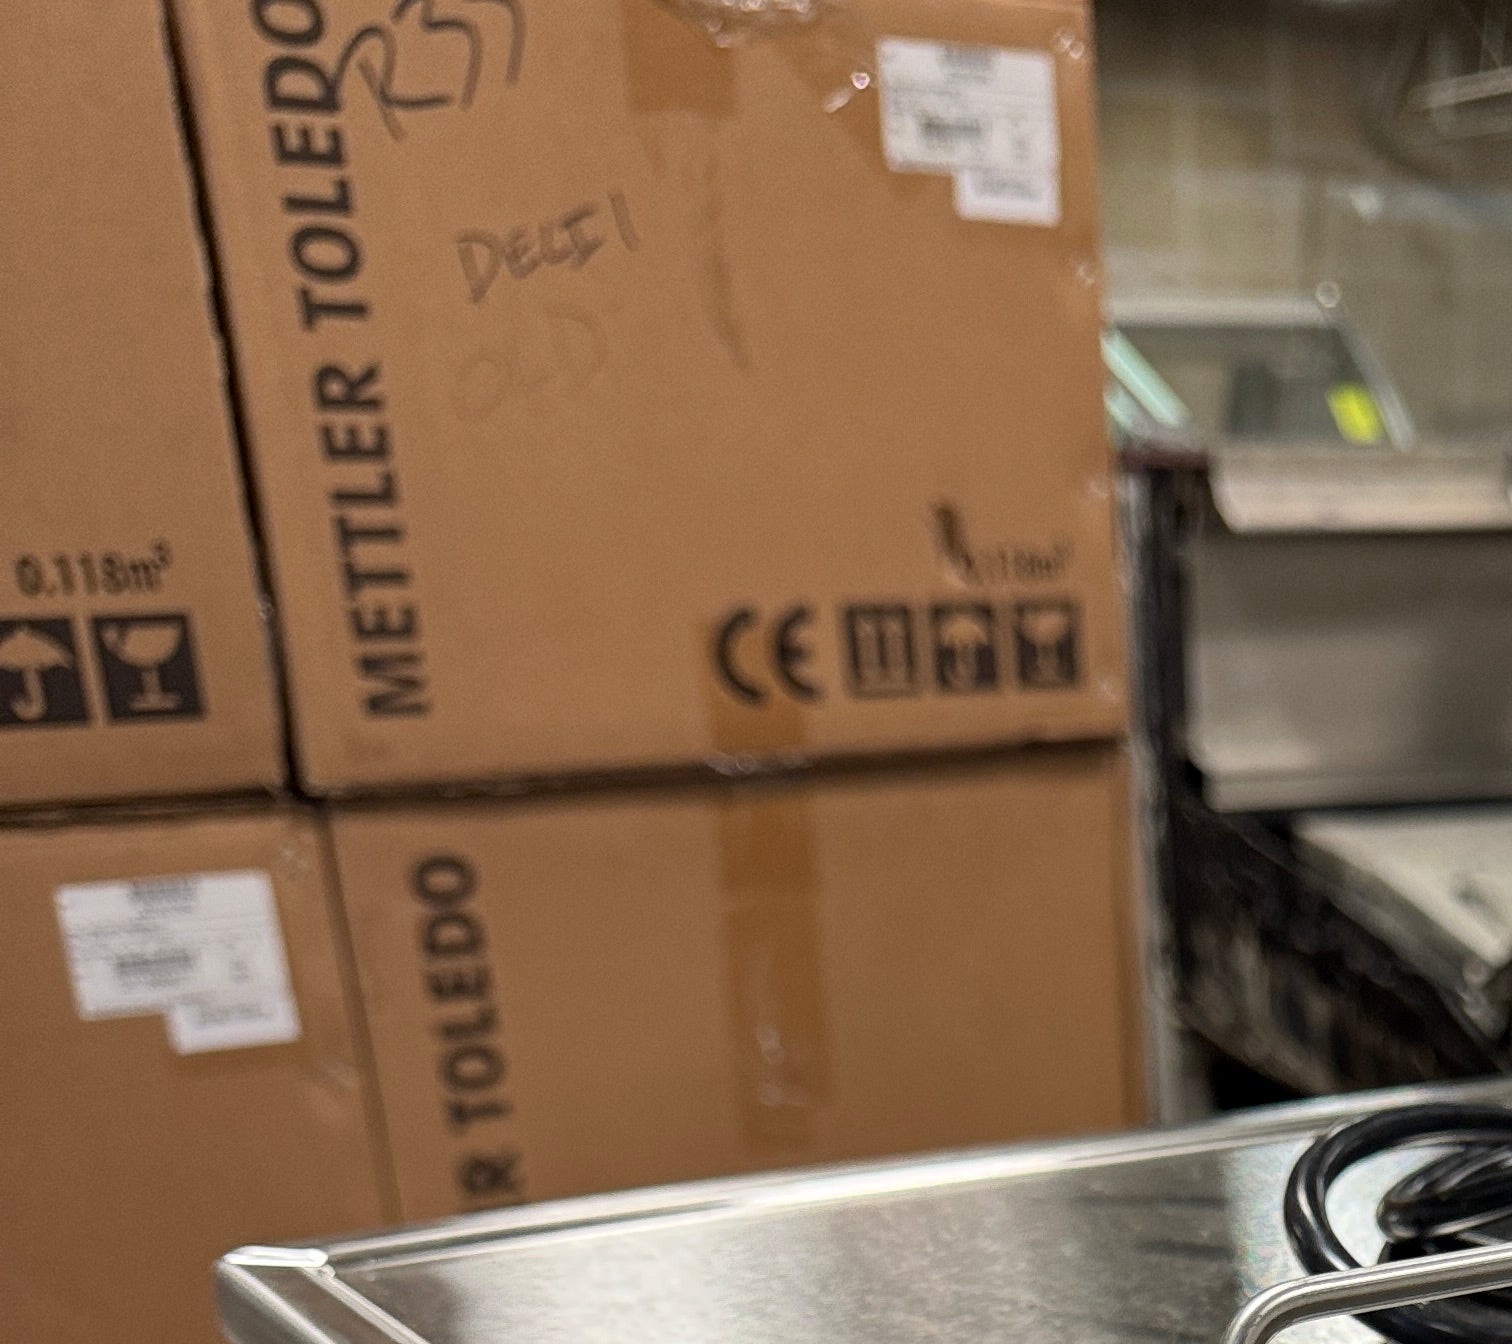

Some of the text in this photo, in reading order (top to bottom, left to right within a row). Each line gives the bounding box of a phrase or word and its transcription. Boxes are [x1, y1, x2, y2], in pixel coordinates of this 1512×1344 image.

[250, 0, 431, 720] METTLER TOLEDO
[413, 855, 514, 1136] TOLEDO
